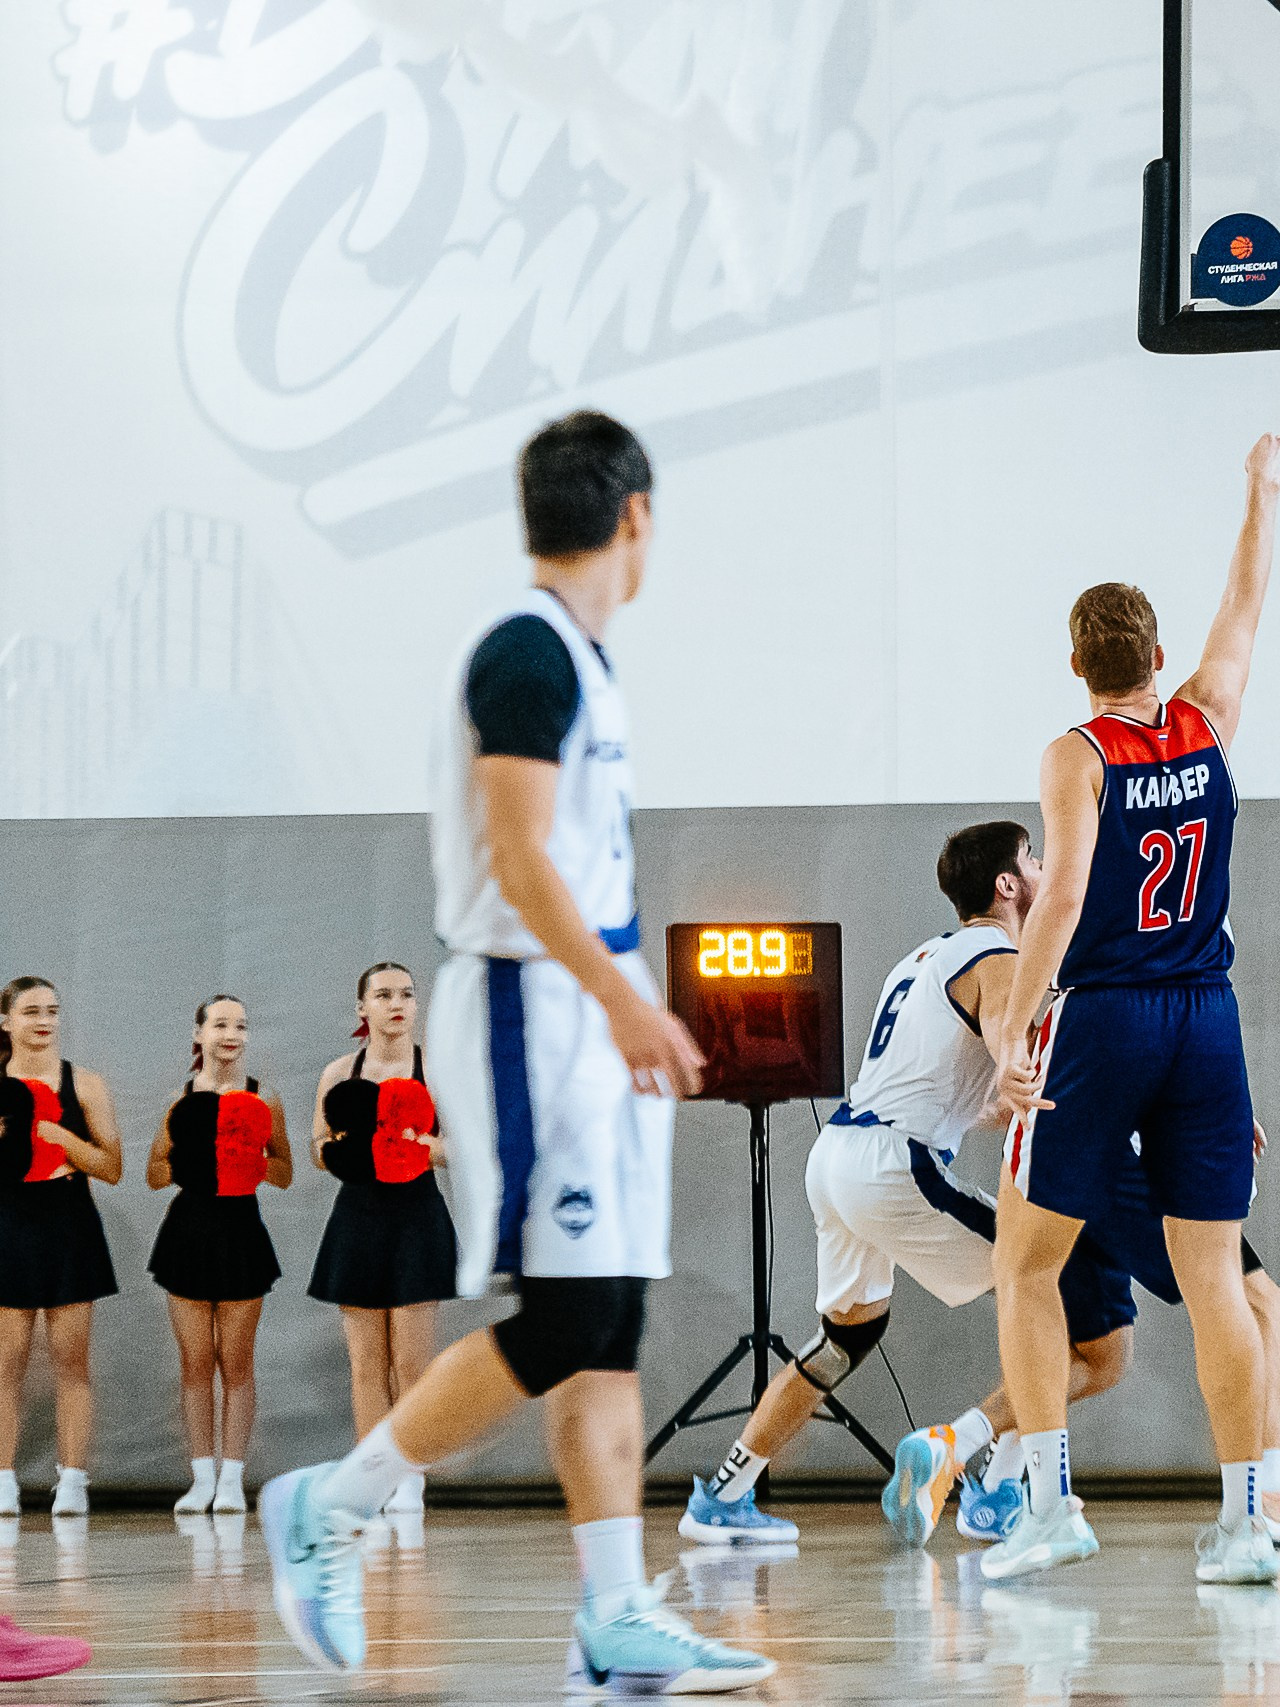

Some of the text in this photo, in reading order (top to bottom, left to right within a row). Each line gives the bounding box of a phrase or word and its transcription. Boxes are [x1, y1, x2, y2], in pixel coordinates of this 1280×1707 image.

[1207, 261, 1278, 275] СТУДЕНЧЕСКАЯ
[1220, 274, 1244, 284] ЛИГА
[1138, 818, 1207, 931] 27
[699, 930, 787, 976] 28.9
[868, 977, 916, 1061] 6
